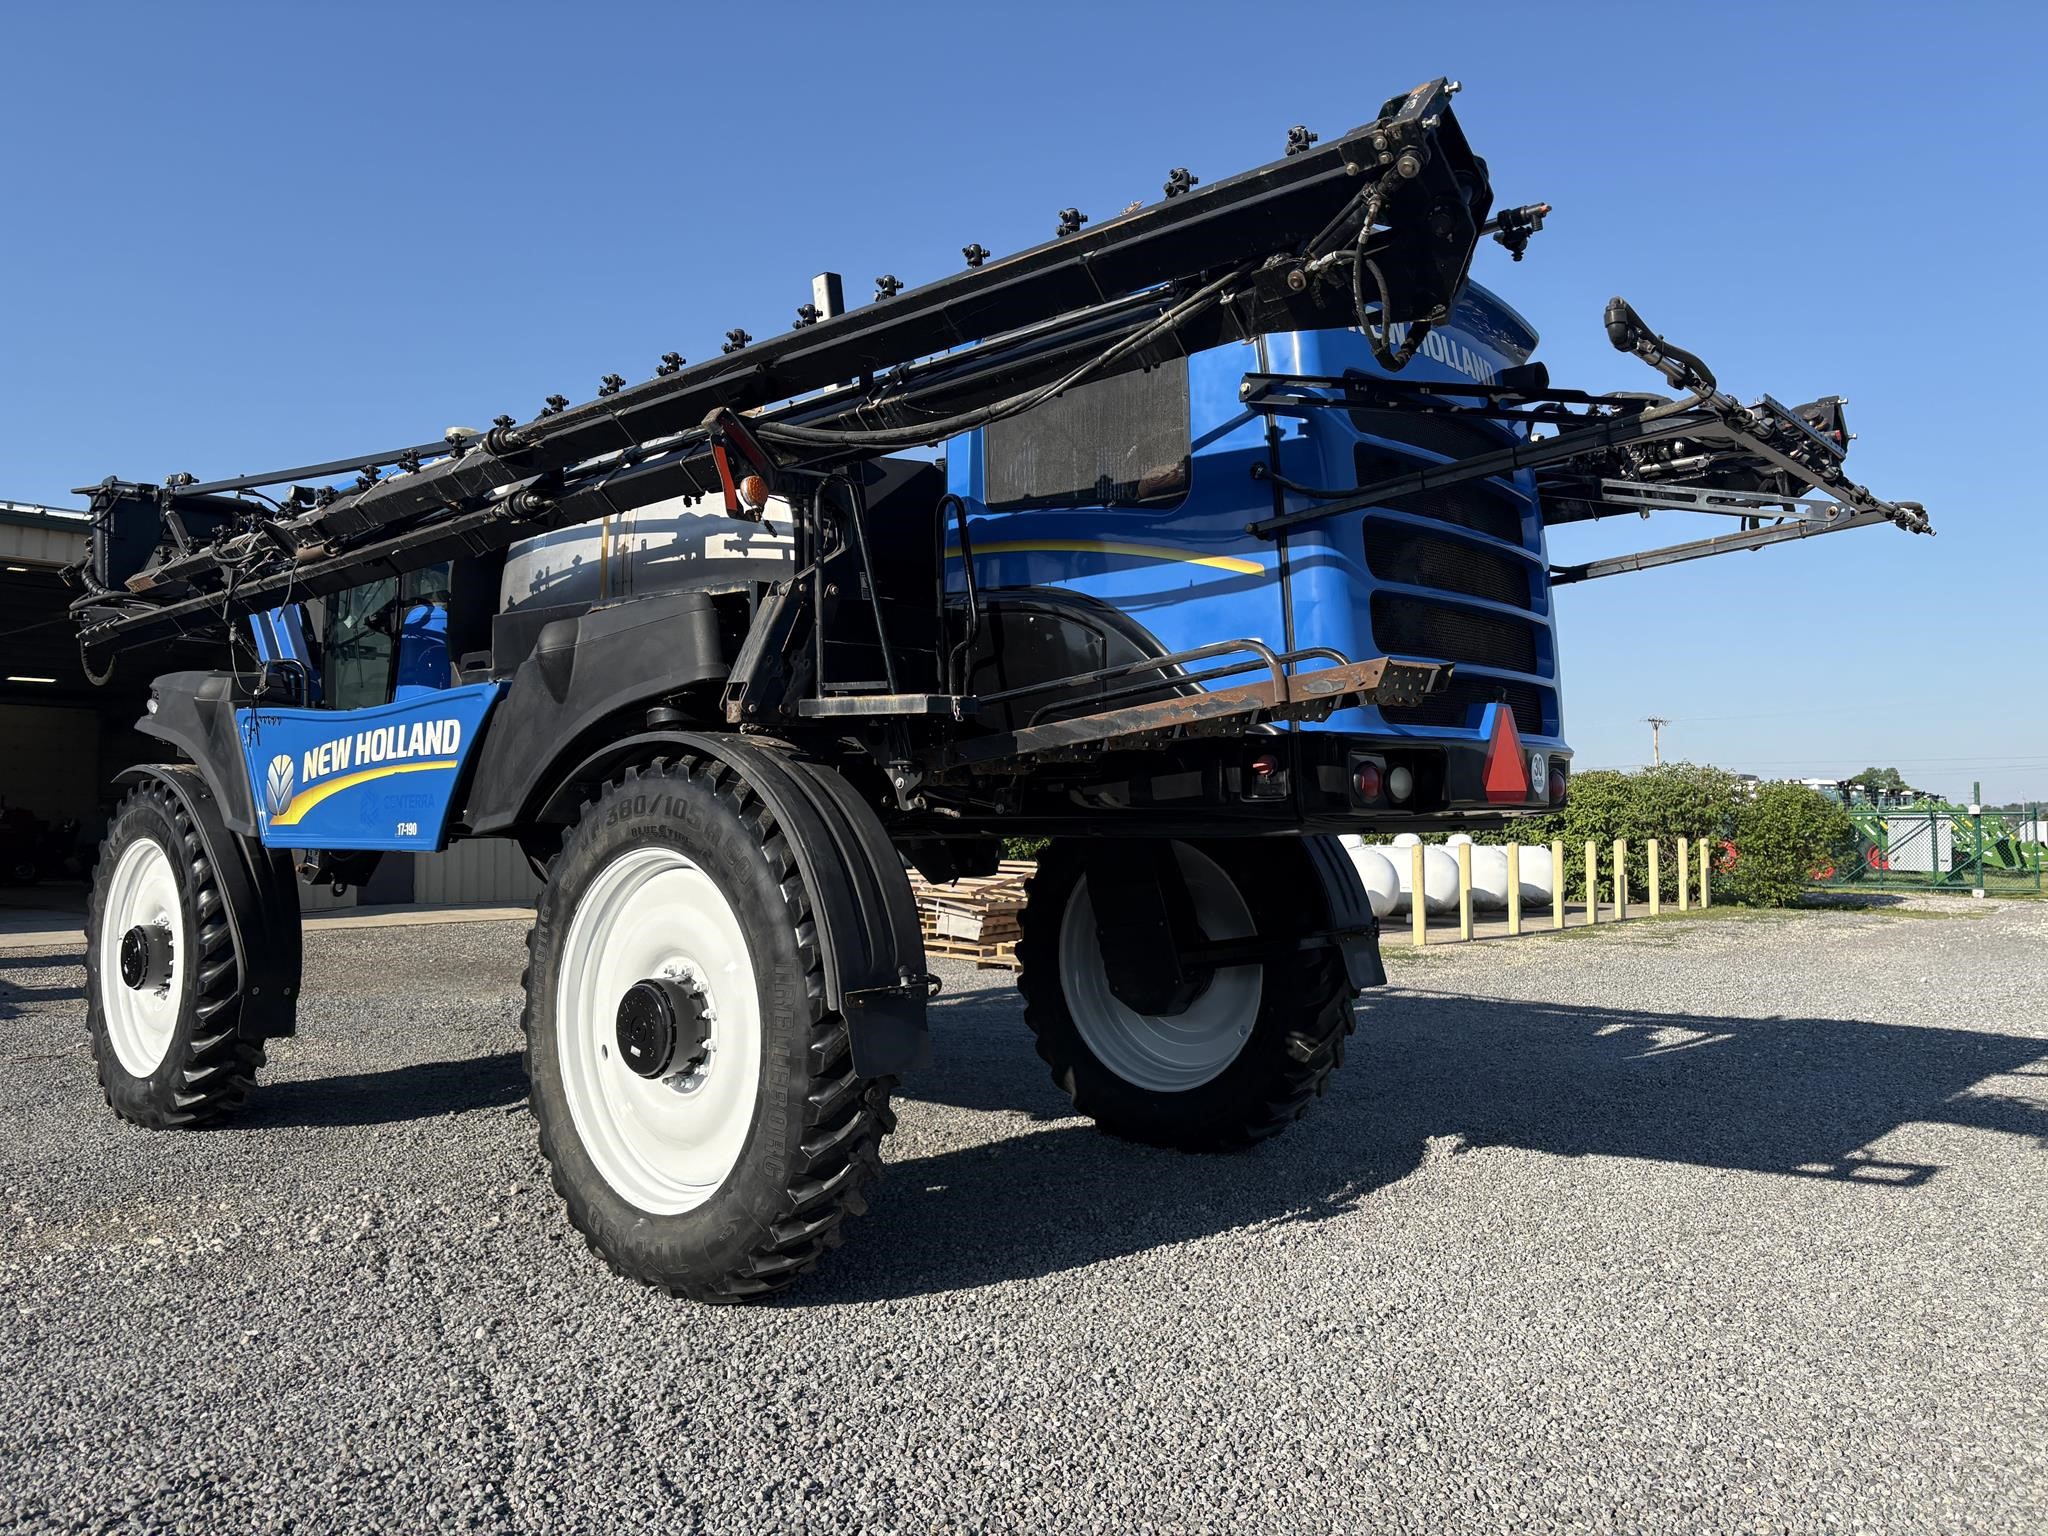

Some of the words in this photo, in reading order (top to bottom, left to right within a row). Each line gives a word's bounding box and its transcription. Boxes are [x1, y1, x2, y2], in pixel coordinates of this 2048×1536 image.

[302, 735, 352, 784] NEW
[355, 719, 461, 765] HOLLAND
[1534, 756, 1543, 777] 30
[396, 822, 417, 836] 17-190
[763, 956, 800, 1183] TRELLEBORG
